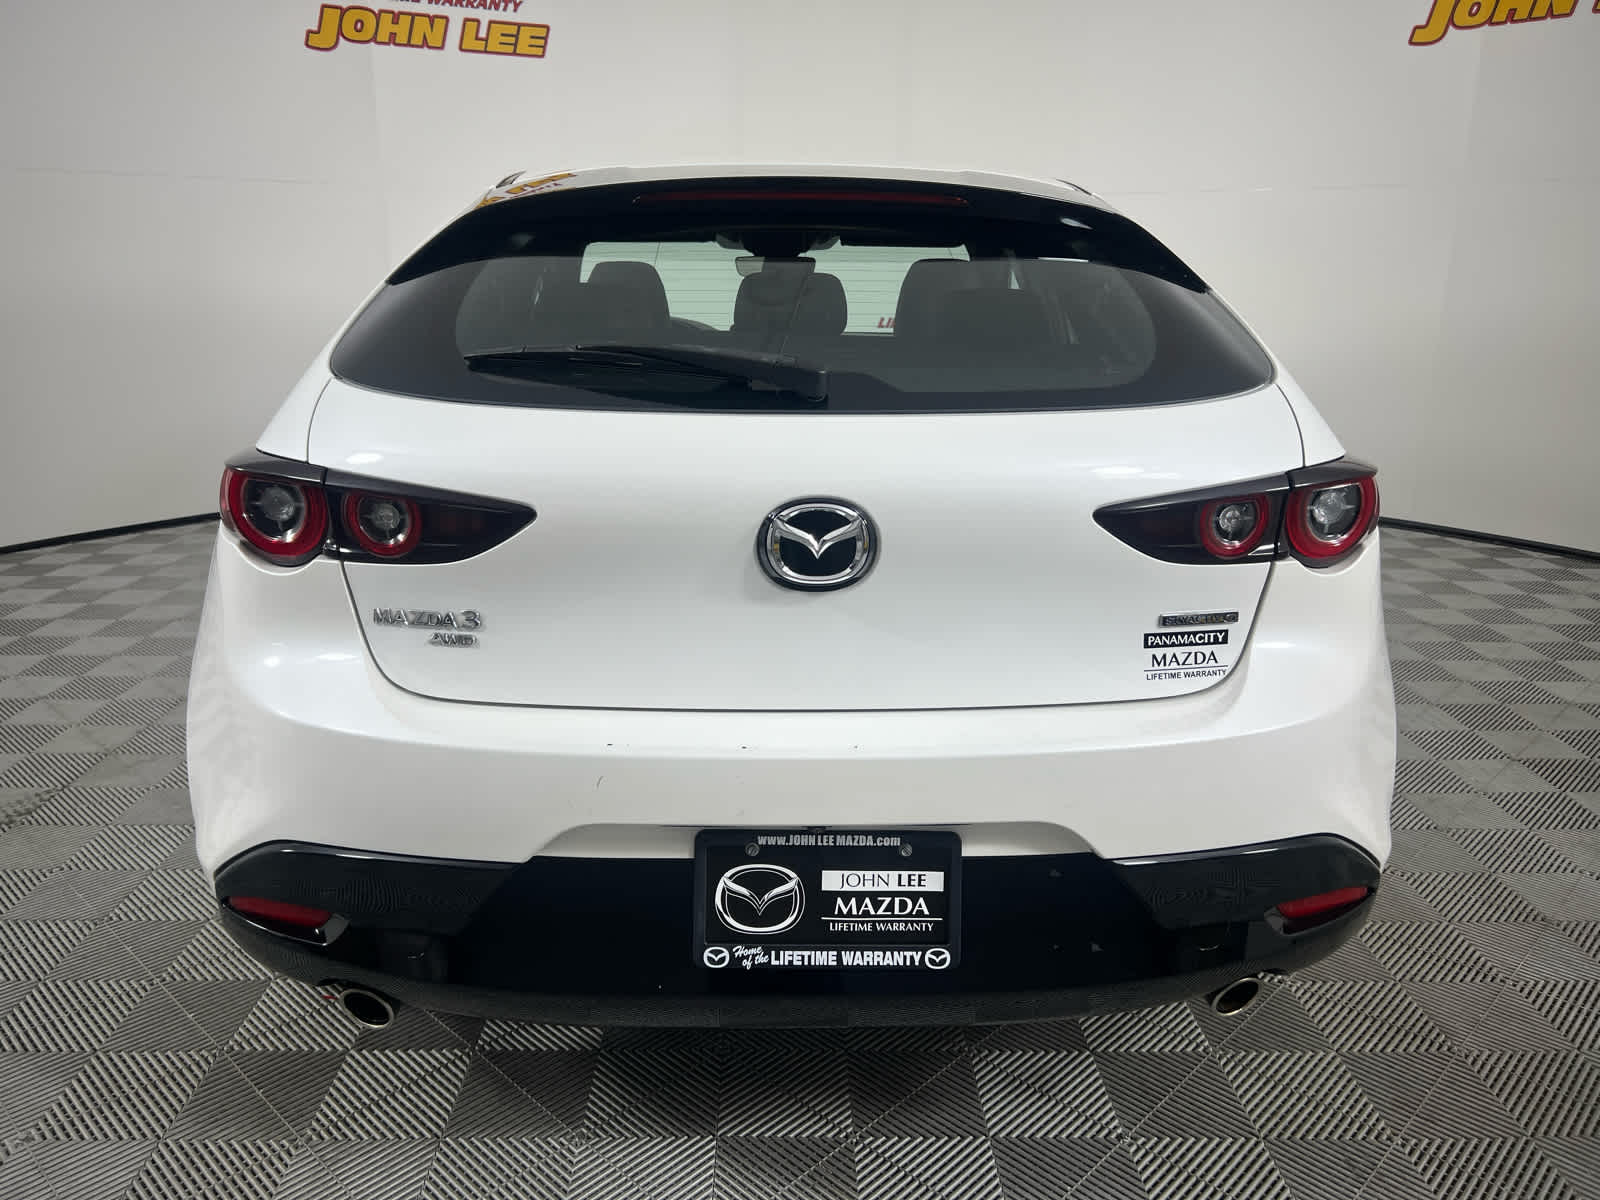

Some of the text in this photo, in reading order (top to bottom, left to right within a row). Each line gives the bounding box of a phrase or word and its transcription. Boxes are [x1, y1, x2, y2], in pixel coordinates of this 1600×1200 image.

[304, 4, 550, 57] JOHN LEE
[429, 632, 477, 648] AWD
[1147, 632, 1225, 646] PANAMACITY
[1151, 650, 1219, 667] MAZDA
[1146, 669, 1227, 681] LIFETIME WARRANTY
[757, 834, 901, 846] www.JOHN LEE MAZDA.com
[840, 873, 927, 889] JOHN LEE
[834, 896, 930, 915] MAZDA
[829, 922, 934, 931] LIFETIME WARRANTY
[733, 945, 762, 958] Home
[770, 950, 922, 966] LIFETIME WARRANTY
[742, 951, 769, 970] of the
